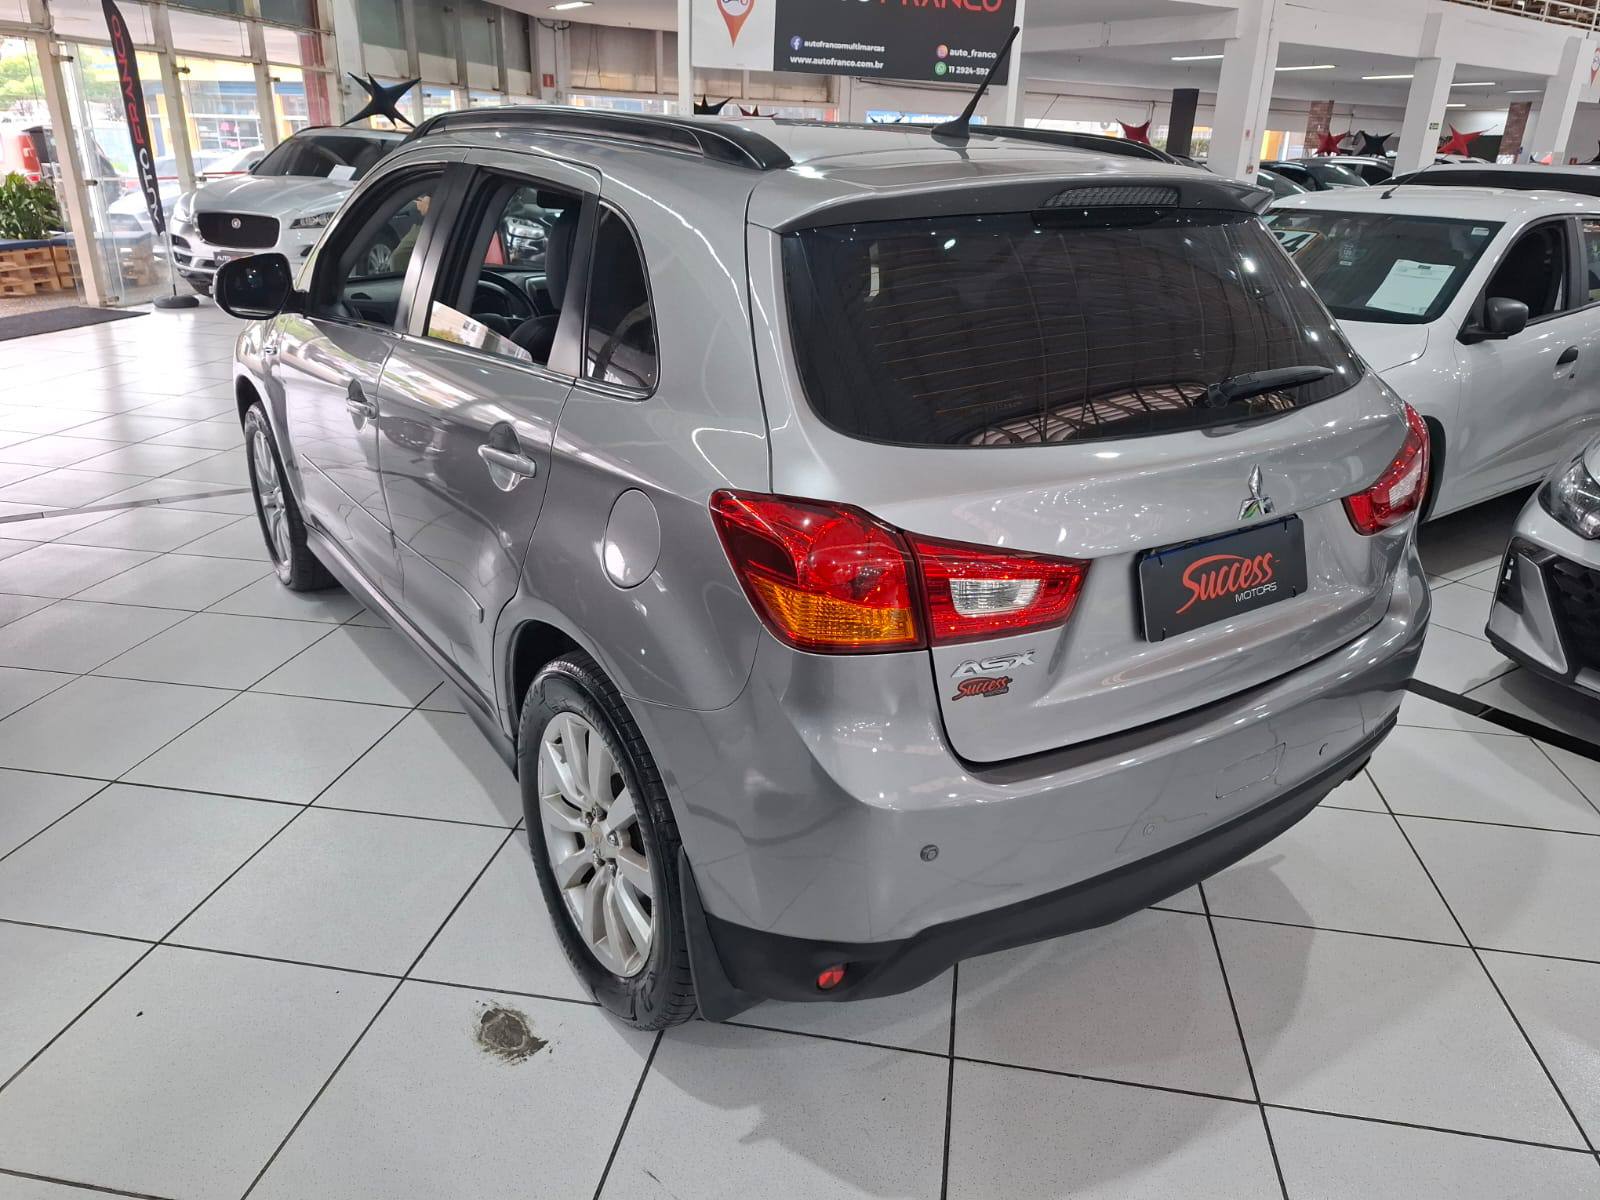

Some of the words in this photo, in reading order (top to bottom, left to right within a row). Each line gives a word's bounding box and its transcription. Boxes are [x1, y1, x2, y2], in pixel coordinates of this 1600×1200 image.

[803, 40, 886, 53] autofrancomultimarcas
[949, 48, 998, 59] auto_franco
[789, 56, 885, 69] www.autofranco.com.br
[948, 65, 956, 74] 11
[111, 15, 144, 145] FRANCO
[138, 146, 161, 223] AUTO
[1175, 551, 1274, 615] Success
[1234, 581, 1278, 603] MOTORS
[951, 649, 1035, 678] ASX
[952, 676, 1010, 701] Success
